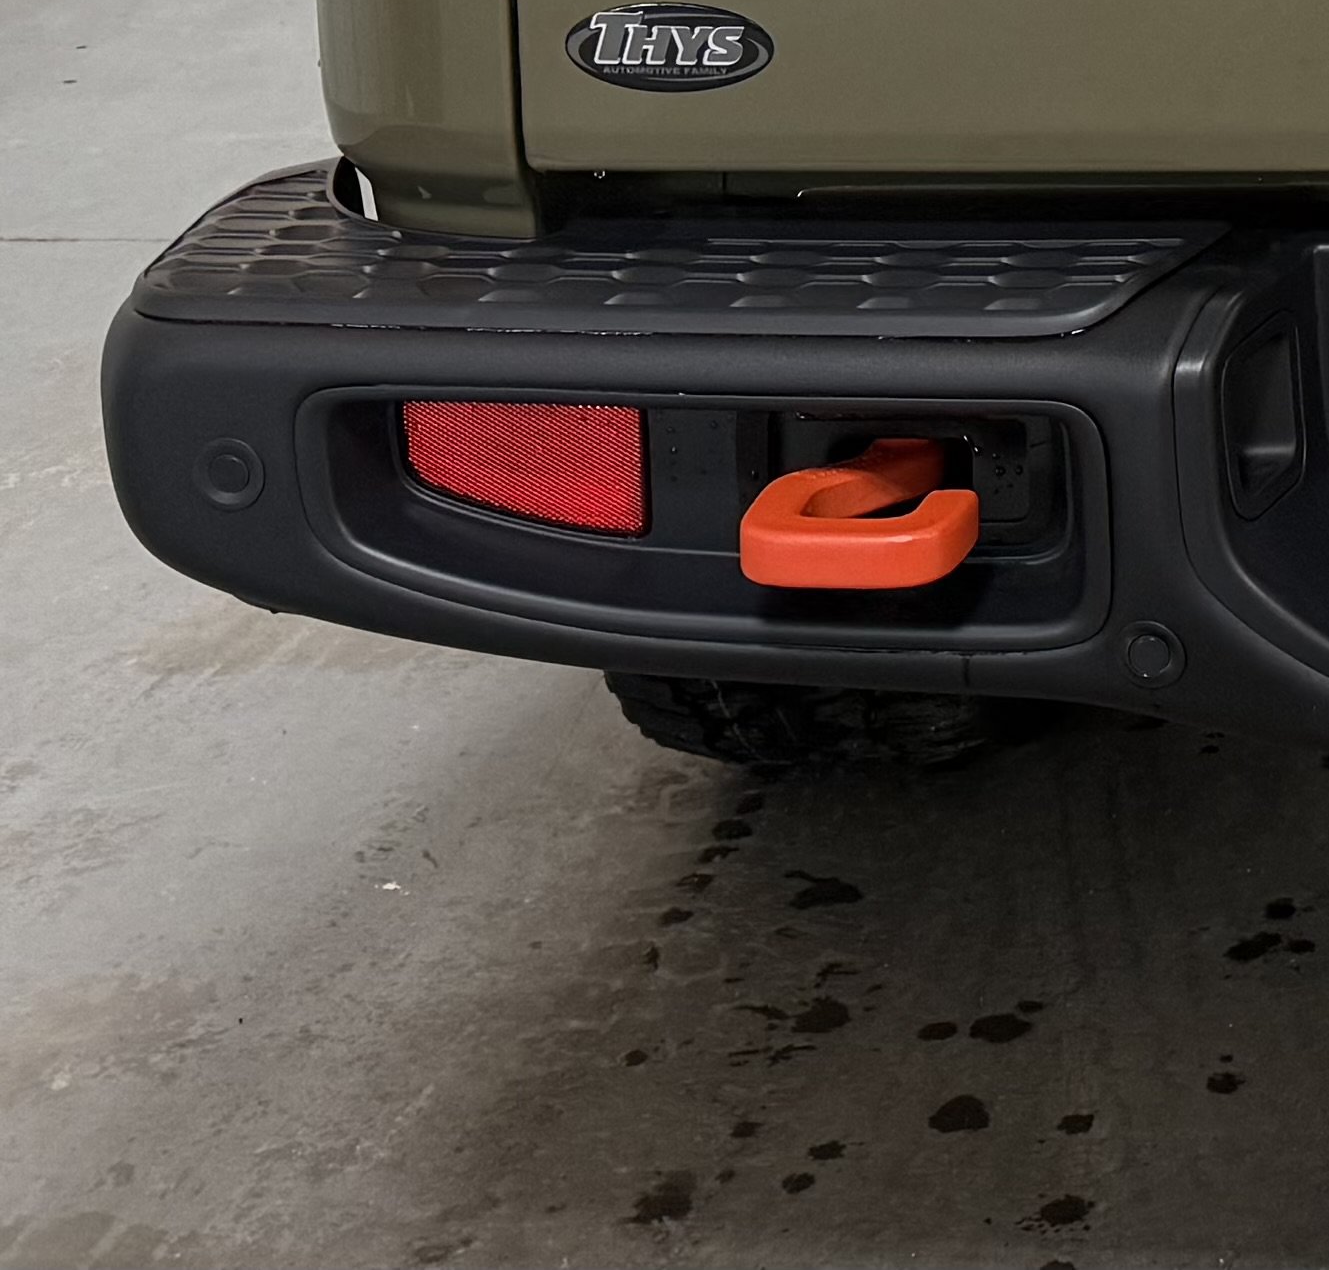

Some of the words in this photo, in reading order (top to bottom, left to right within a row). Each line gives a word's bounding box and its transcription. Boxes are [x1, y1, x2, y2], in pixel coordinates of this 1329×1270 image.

[590, 11, 744, 66] THYS
[603, 66, 680, 75] AUTOMOTIVE
[684, 67, 727, 75] FAMILY
